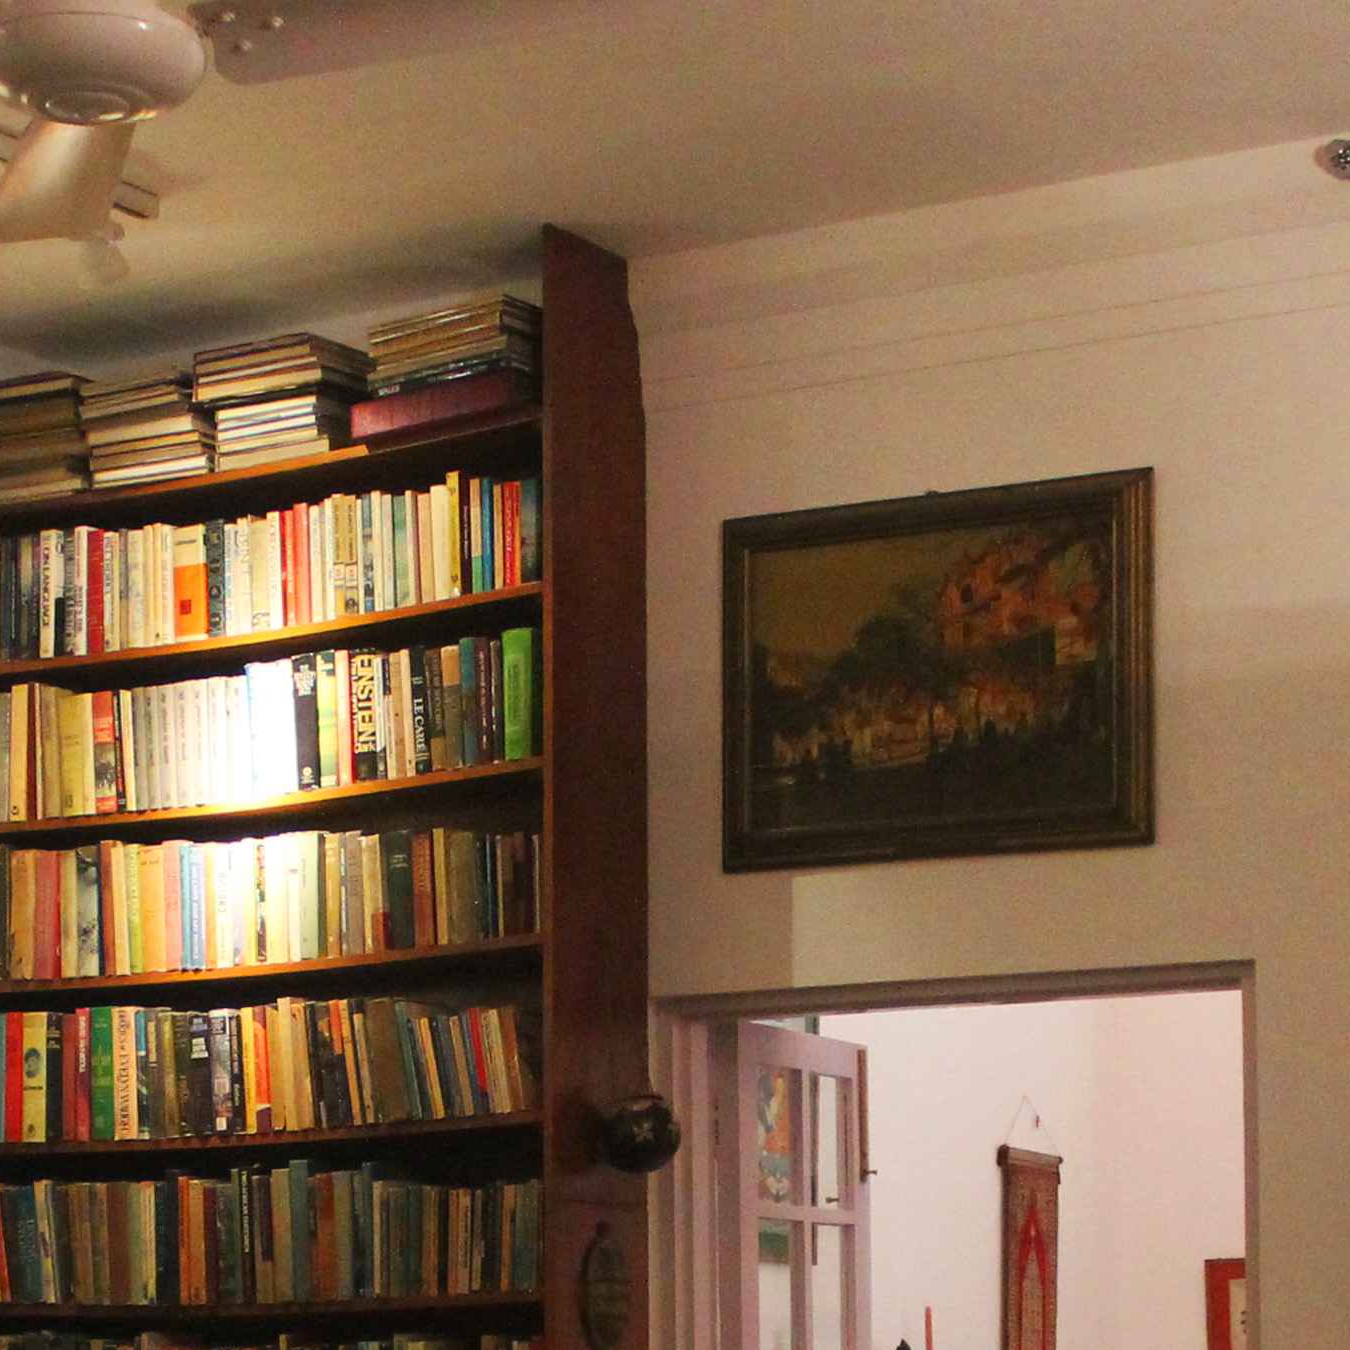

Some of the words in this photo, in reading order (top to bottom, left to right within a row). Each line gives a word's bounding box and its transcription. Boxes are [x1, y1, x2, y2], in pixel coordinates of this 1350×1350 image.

[43, 547, 51, 566] ON
[43, 568, 51, 627] LANGUAGE
[356, 655, 376, 742] EINSTEIN
[414, 698, 424, 714] LE
[119, 1053, 130, 1092] EVELYN
